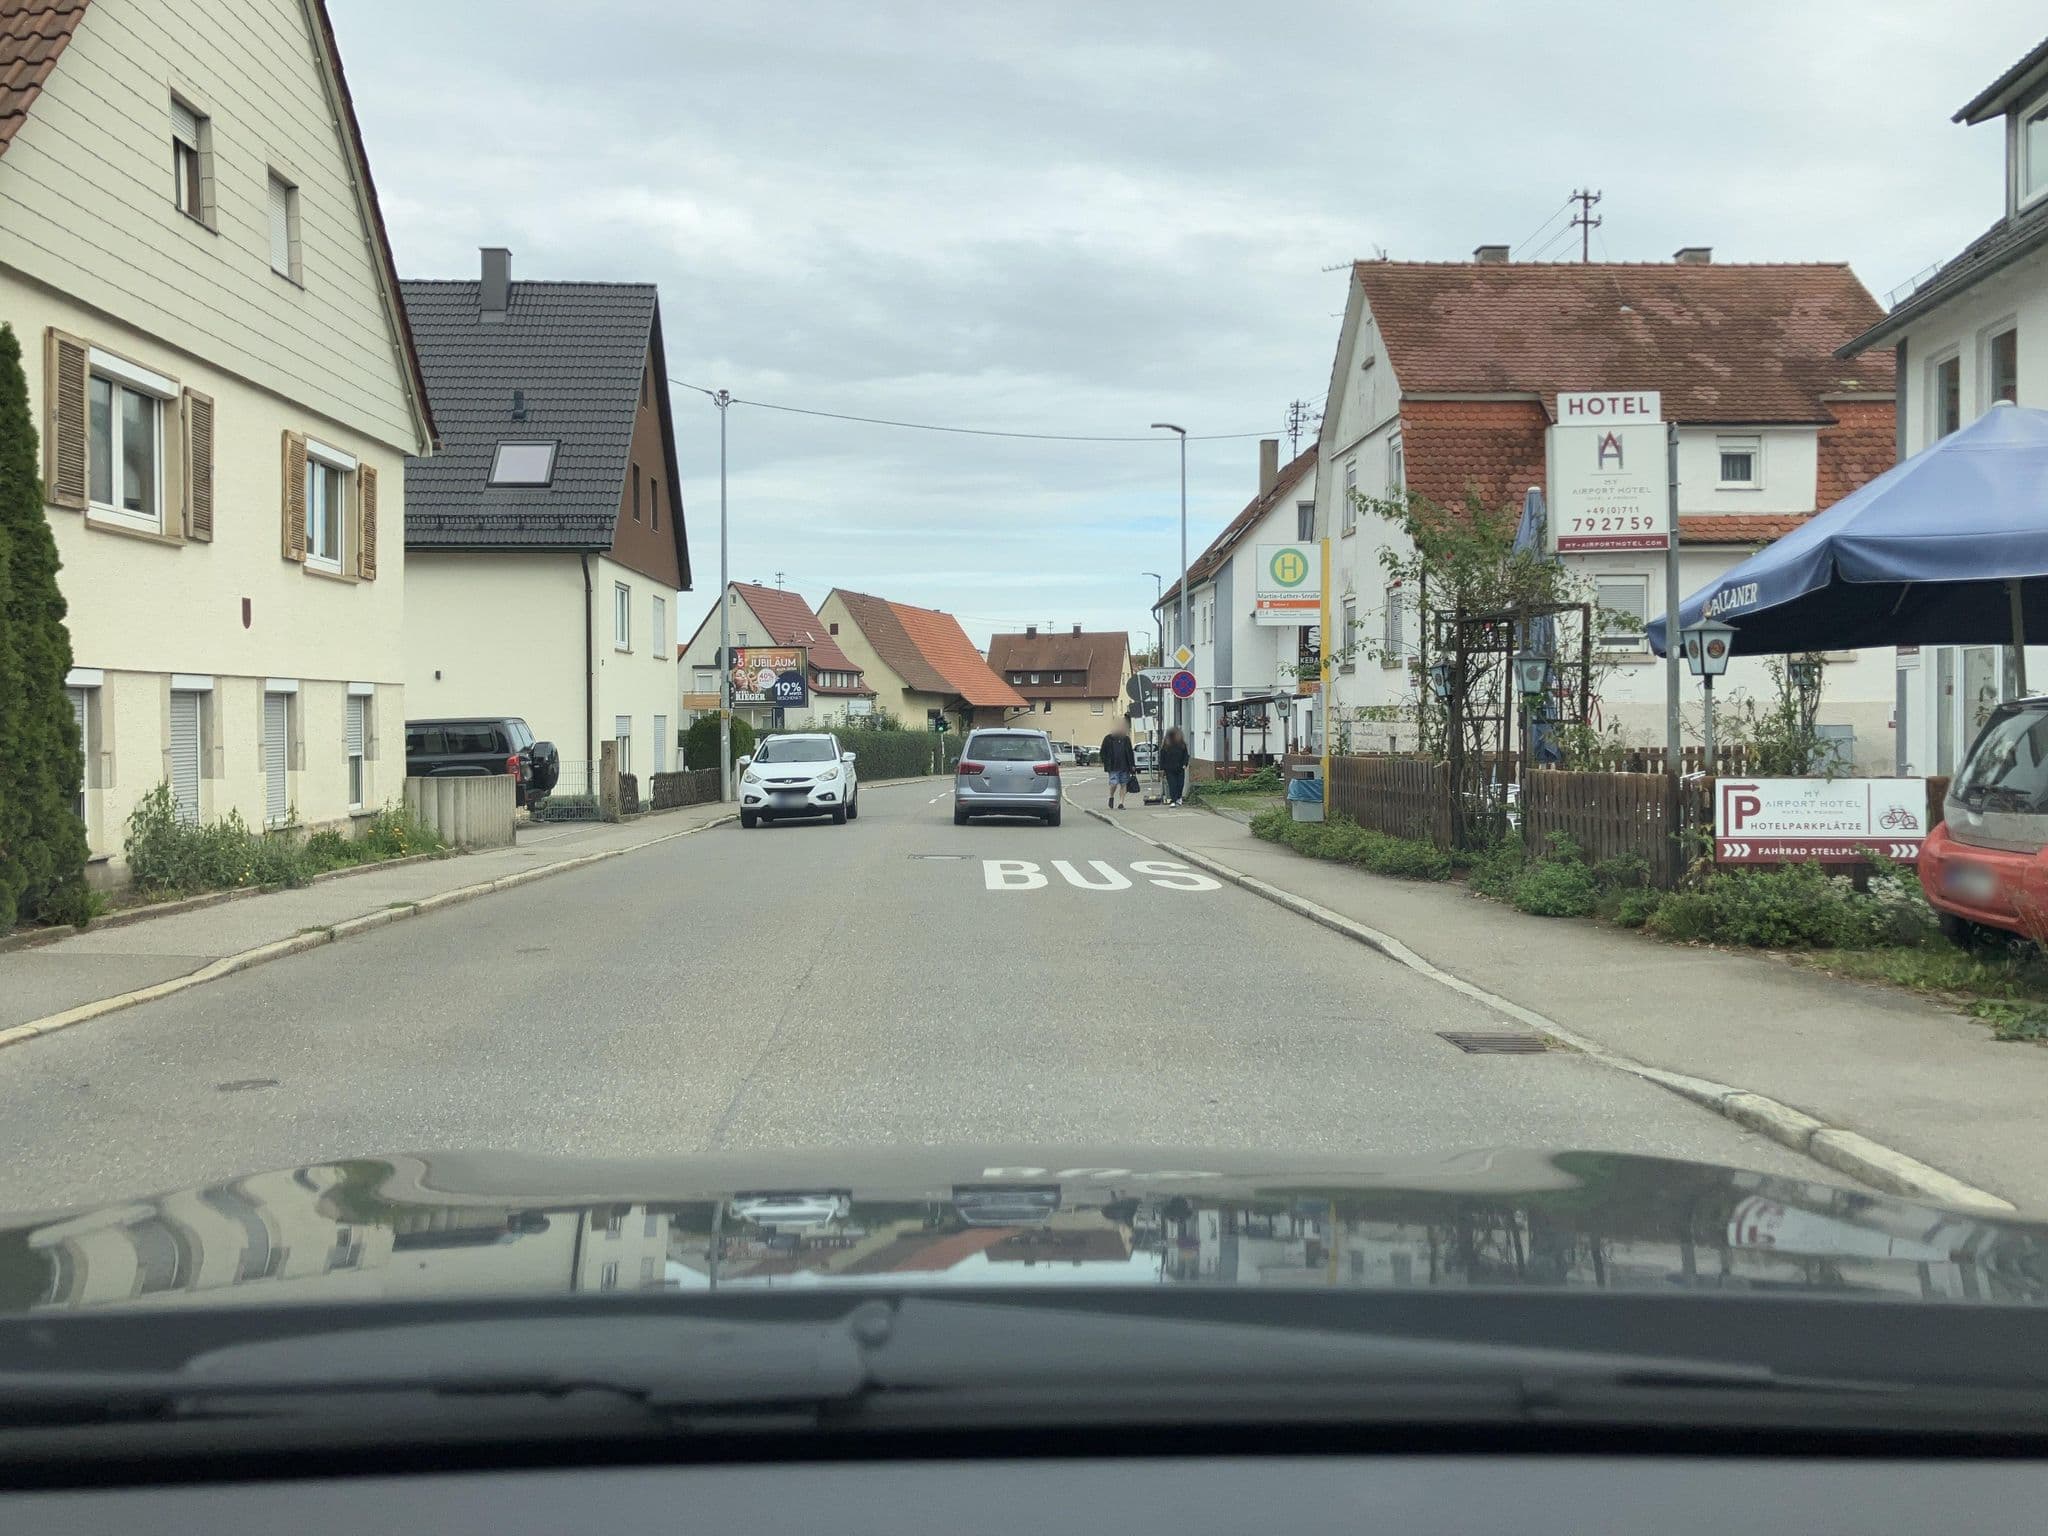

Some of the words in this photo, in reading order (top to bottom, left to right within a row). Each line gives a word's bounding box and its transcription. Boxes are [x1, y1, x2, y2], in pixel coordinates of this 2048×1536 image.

[1569, 397, 1650, 415] HOTEL
[1572, 487, 1615, 495] AIRPORT
[1617, 486, 1652, 494] HOTEL
[1572, 516, 1654, 532] 792759
[1281, 556, 1297, 579] H
[1710, 582, 1758, 616] AULANER
[775, 682, 802, 697] 19%
[1765, 800, 1816, 808] AIRPORT
[1820, 800, 1861, 808] HOTEL
[1735, 796, 1761, 829] P
[1751, 820, 1862, 831] HOTELPARKPLÄTZE
[1758, 847, 1807, 856] FAHRRAD
[1811, 847, 1881, 856] STELLPLE
[982, 860, 1223, 891] BUS
